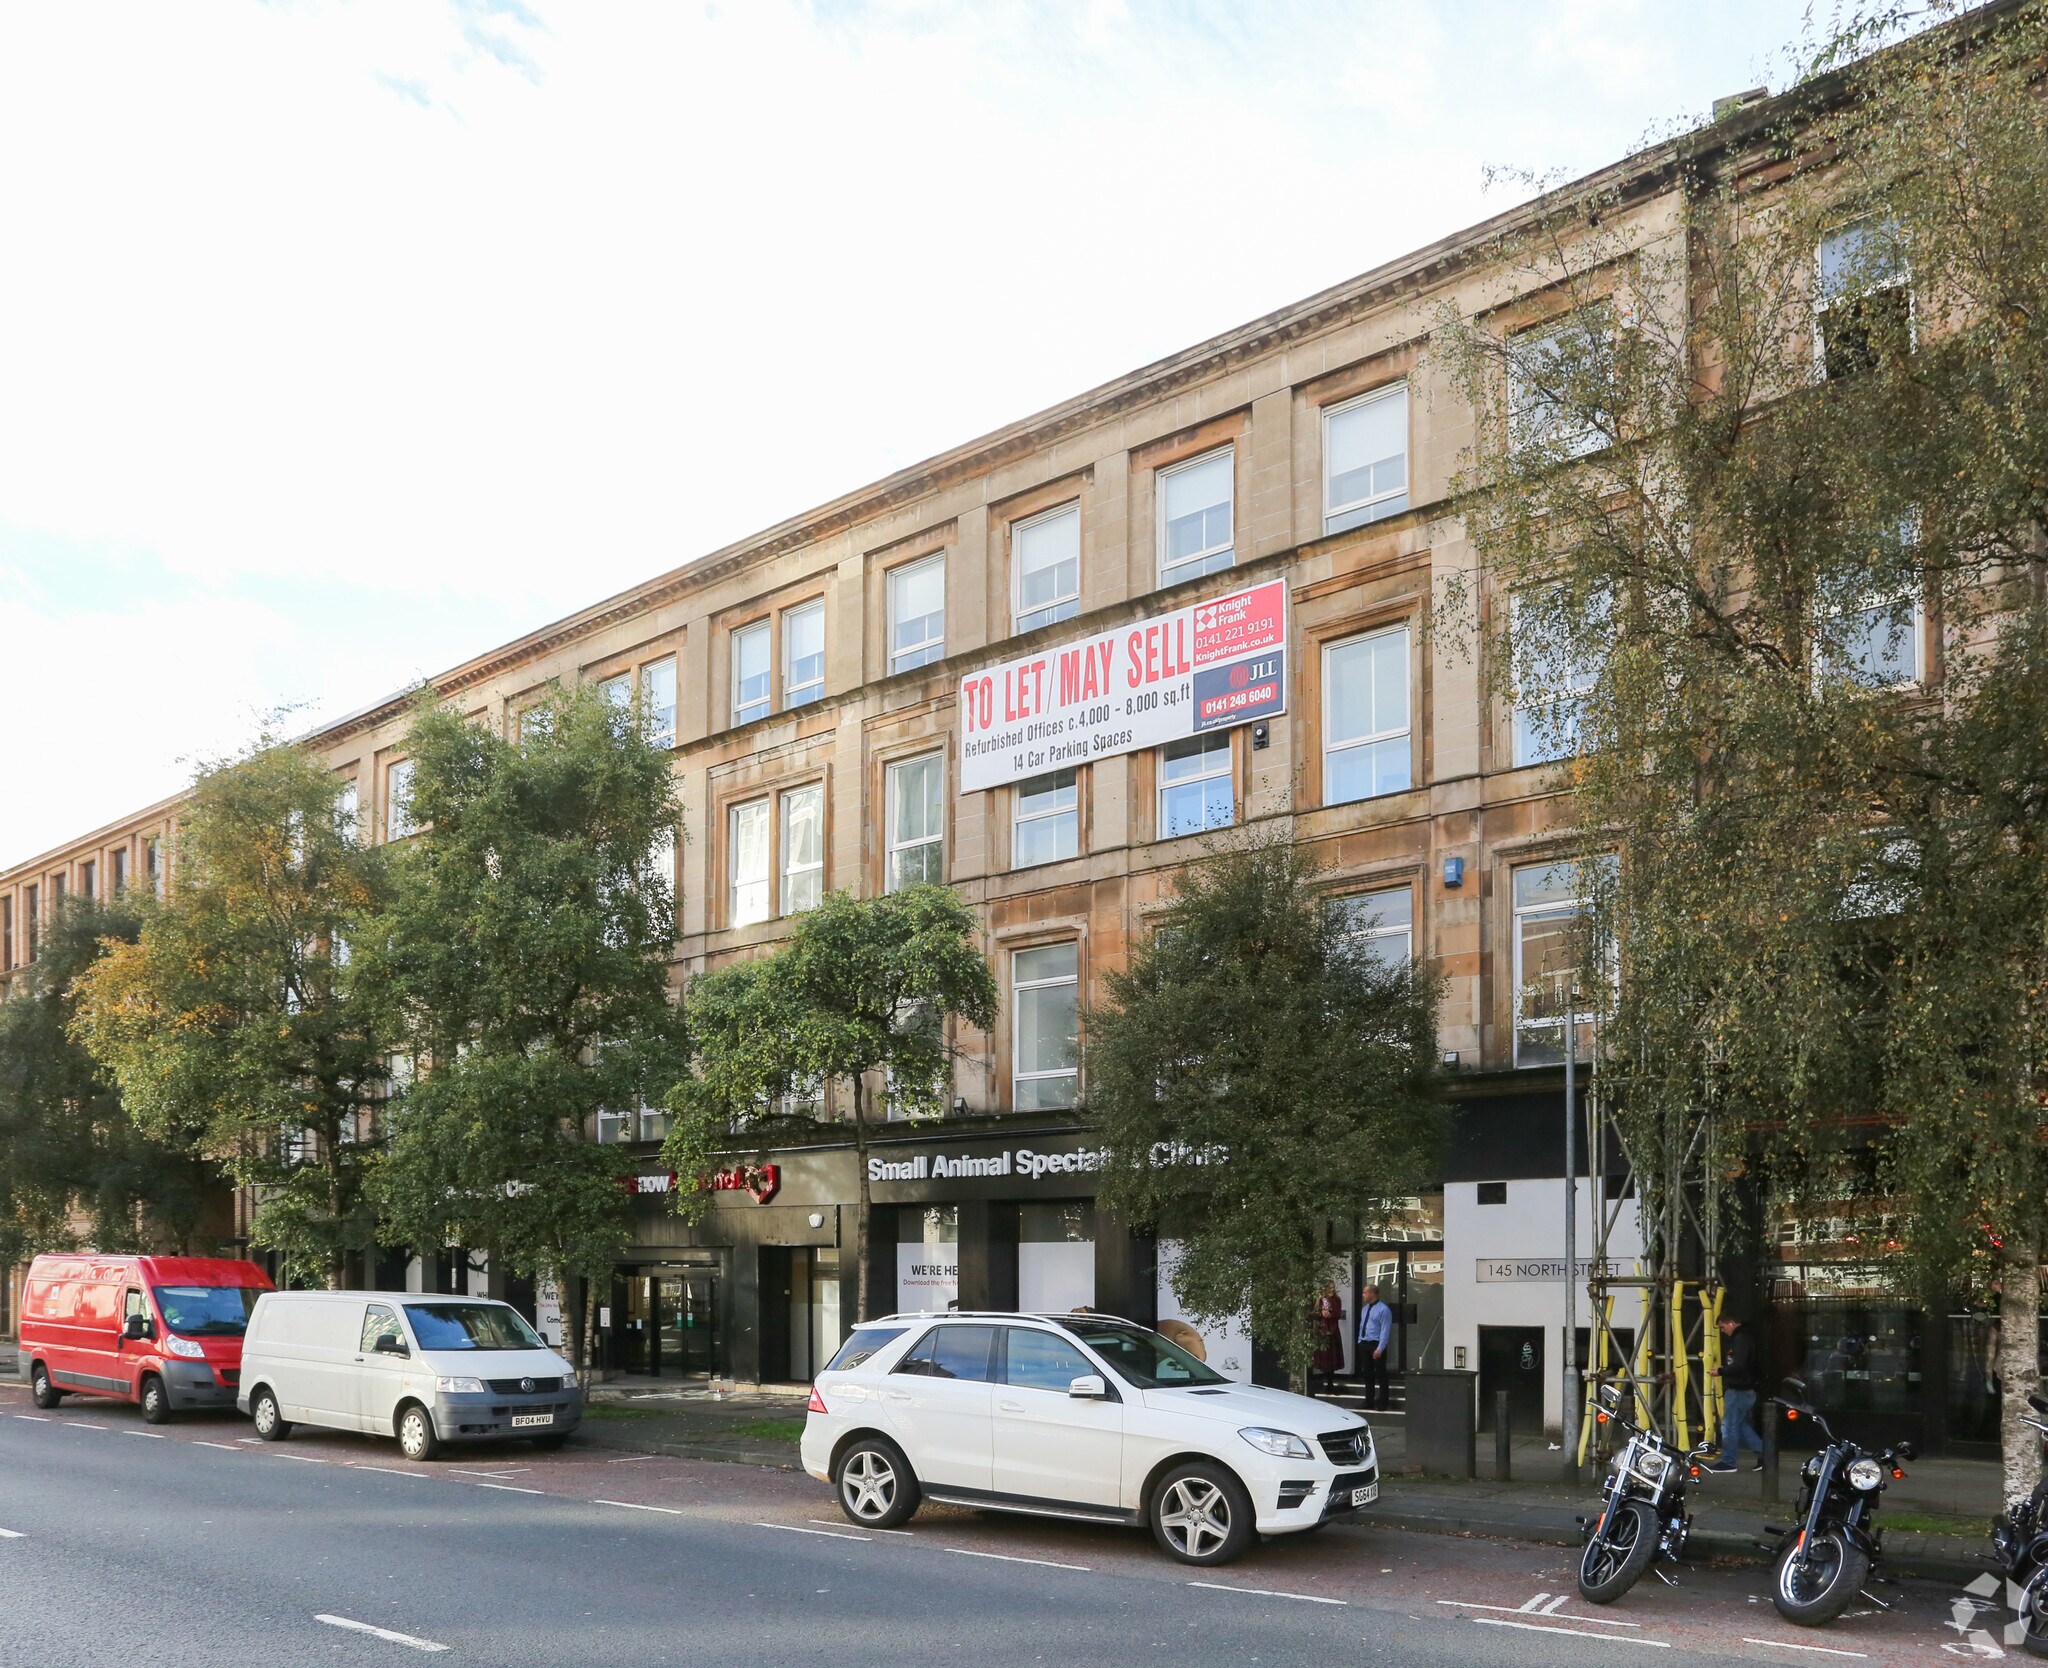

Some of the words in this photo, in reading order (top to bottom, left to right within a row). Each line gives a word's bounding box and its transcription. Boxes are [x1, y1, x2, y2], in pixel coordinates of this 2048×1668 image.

[1218, 595, 1252, 614] Knight
[1218, 610, 1247, 627] Frank
[1196, 632, 1221, 649] 0141
[1225, 626, 1244, 641] 221
[1247, 617, 1274, 634] 9191
[1195, 633, 1275, 662] KnightFrank.co.uk
[964, 676, 993, 732] TO
[1127, 618, 1190, 688] SELL
[1249, 660, 1277, 681] JLL
[1206, 698, 1227, 714] 0141
[1230, 692, 1247, 708] 248
[1248, 686, 1271, 703] 6040
[965, 728, 1023, 758] Refurbished
[1027, 720, 1064, 742] Offices
[1068, 704, 1110, 731] c.4,000
[1126, 691, 1158, 716] 8,000
[1163, 682, 1190, 706] sq.ft
[1013, 754, 1023, 771] 14
[1028, 751, 1045, 768] Car
[1049, 738, 1088, 763] Parking
[1093, 729, 1132, 752] Spaces
[868, 1156, 927, 1181] Small
[932, 1151, 1011, 1179] Animal
[911, 1265, 942, 1276] WE'RE
[1488, 1264, 1512, 1276] 145
[1516, 1263, 1566, 1277] NORTH
[940, 1279, 951, 1287] free
[515, 1417, 535, 1426] BF04
